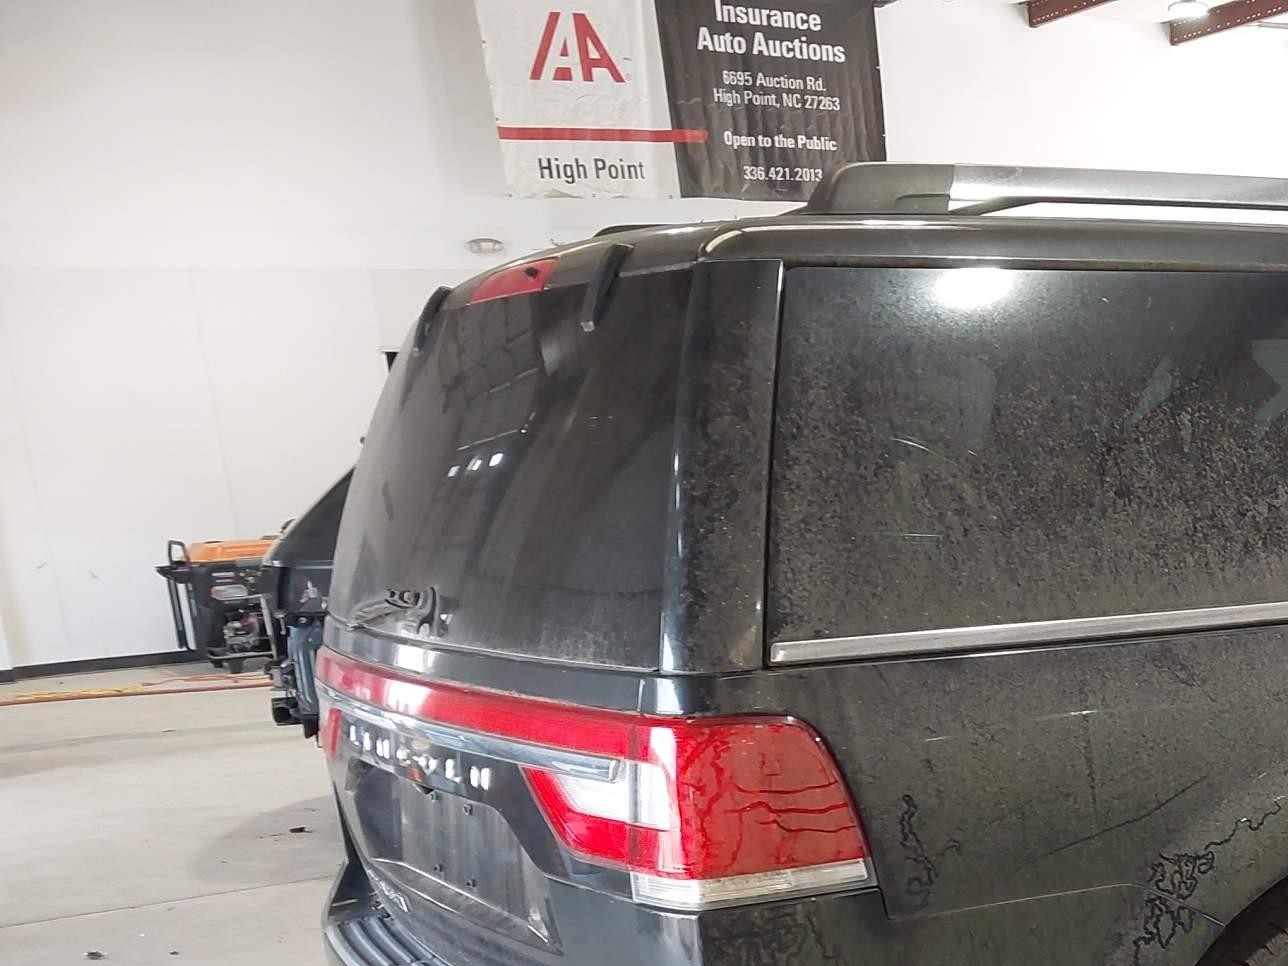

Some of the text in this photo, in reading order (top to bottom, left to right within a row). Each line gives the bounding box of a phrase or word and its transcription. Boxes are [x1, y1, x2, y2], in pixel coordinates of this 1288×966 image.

[714, 0, 822, 31] Insurance
[697, 26, 846, 63] Auto Auctions
[722, 70, 827, 92] 6695 Auction Rd.
[713, 88, 840, 111] High Point, NC 27263
[723, 130, 839, 151] Open to the Public
[537, 157, 646, 184] High Point
[743, 165, 823, 182] 336.421.2013
